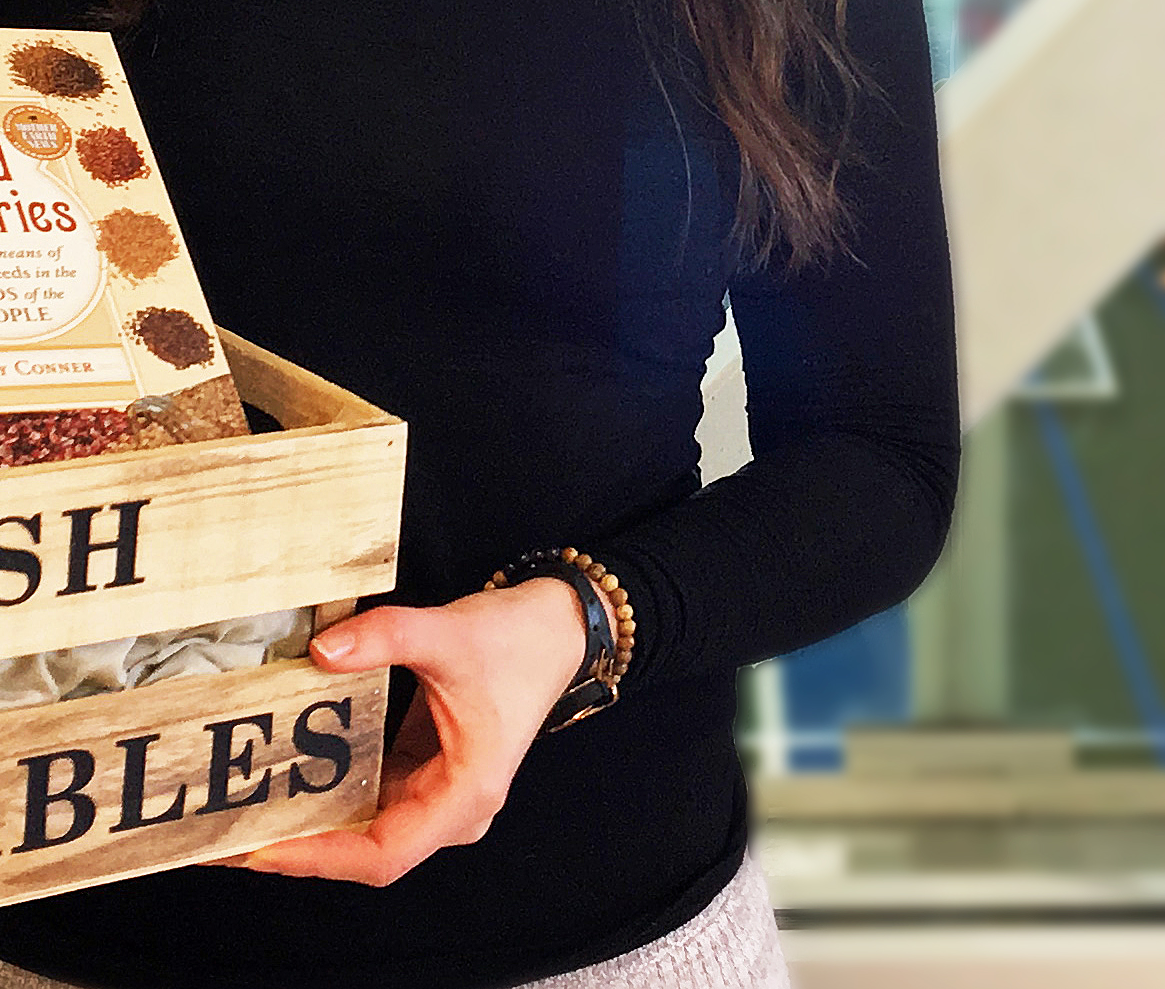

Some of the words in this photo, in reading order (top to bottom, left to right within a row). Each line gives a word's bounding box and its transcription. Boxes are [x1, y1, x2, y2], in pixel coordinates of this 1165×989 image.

[47, 245, 64, 262] of
[35, 267, 50, 279] in
[55, 266, 76, 279] the
[24, 287, 40, 304] of
[43, 286, 64, 300] the
